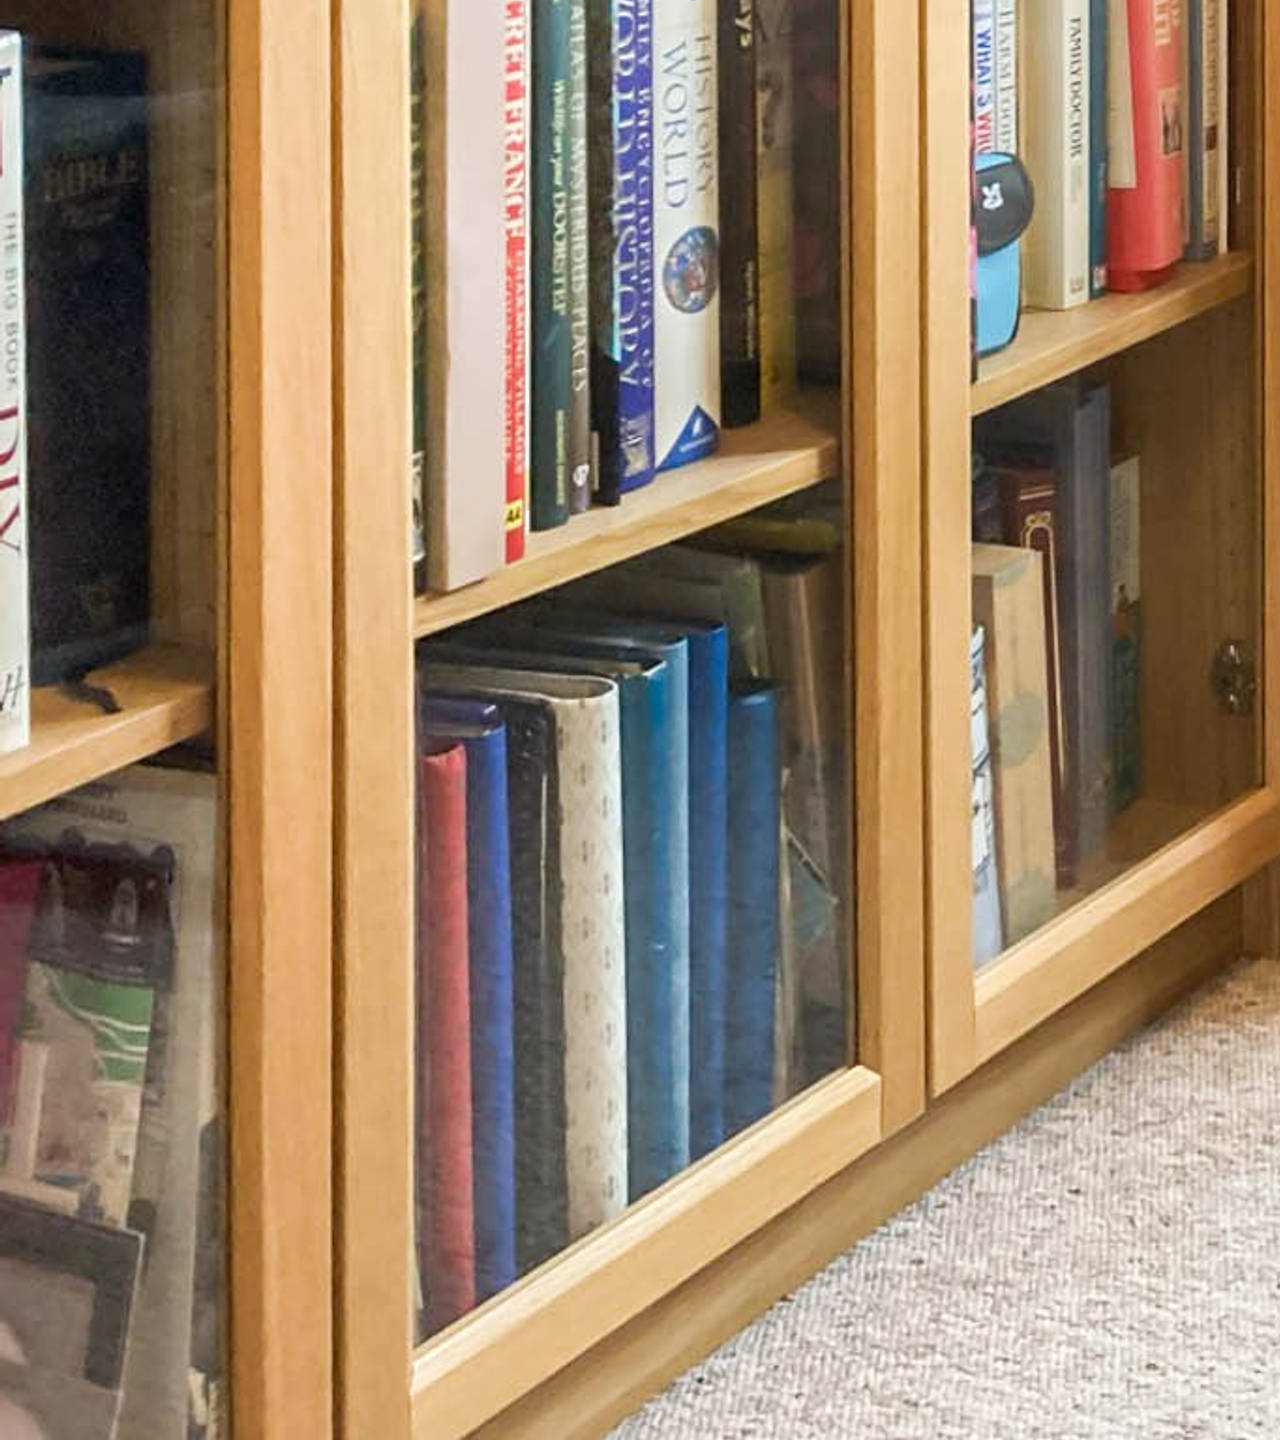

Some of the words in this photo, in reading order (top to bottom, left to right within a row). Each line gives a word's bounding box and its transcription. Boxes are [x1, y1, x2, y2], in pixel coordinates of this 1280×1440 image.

[569, 6, 585, 79] ATLAS
[1069, 17, 1082, 77] FAMILY
[569, 92, 585, 120] OF
[662, 41, 689, 210] WORLD
[694, 35, 714, 195] HISTORY
[1069, 80, 1082, 159] DOCTOR
[505, 99, 525, 237] FRANCE
[569, 137, 586, 293] MYSTERIOUS
[553, 192, 567, 315] DOORSTEP
[570, 308, 588, 392] PLACES
